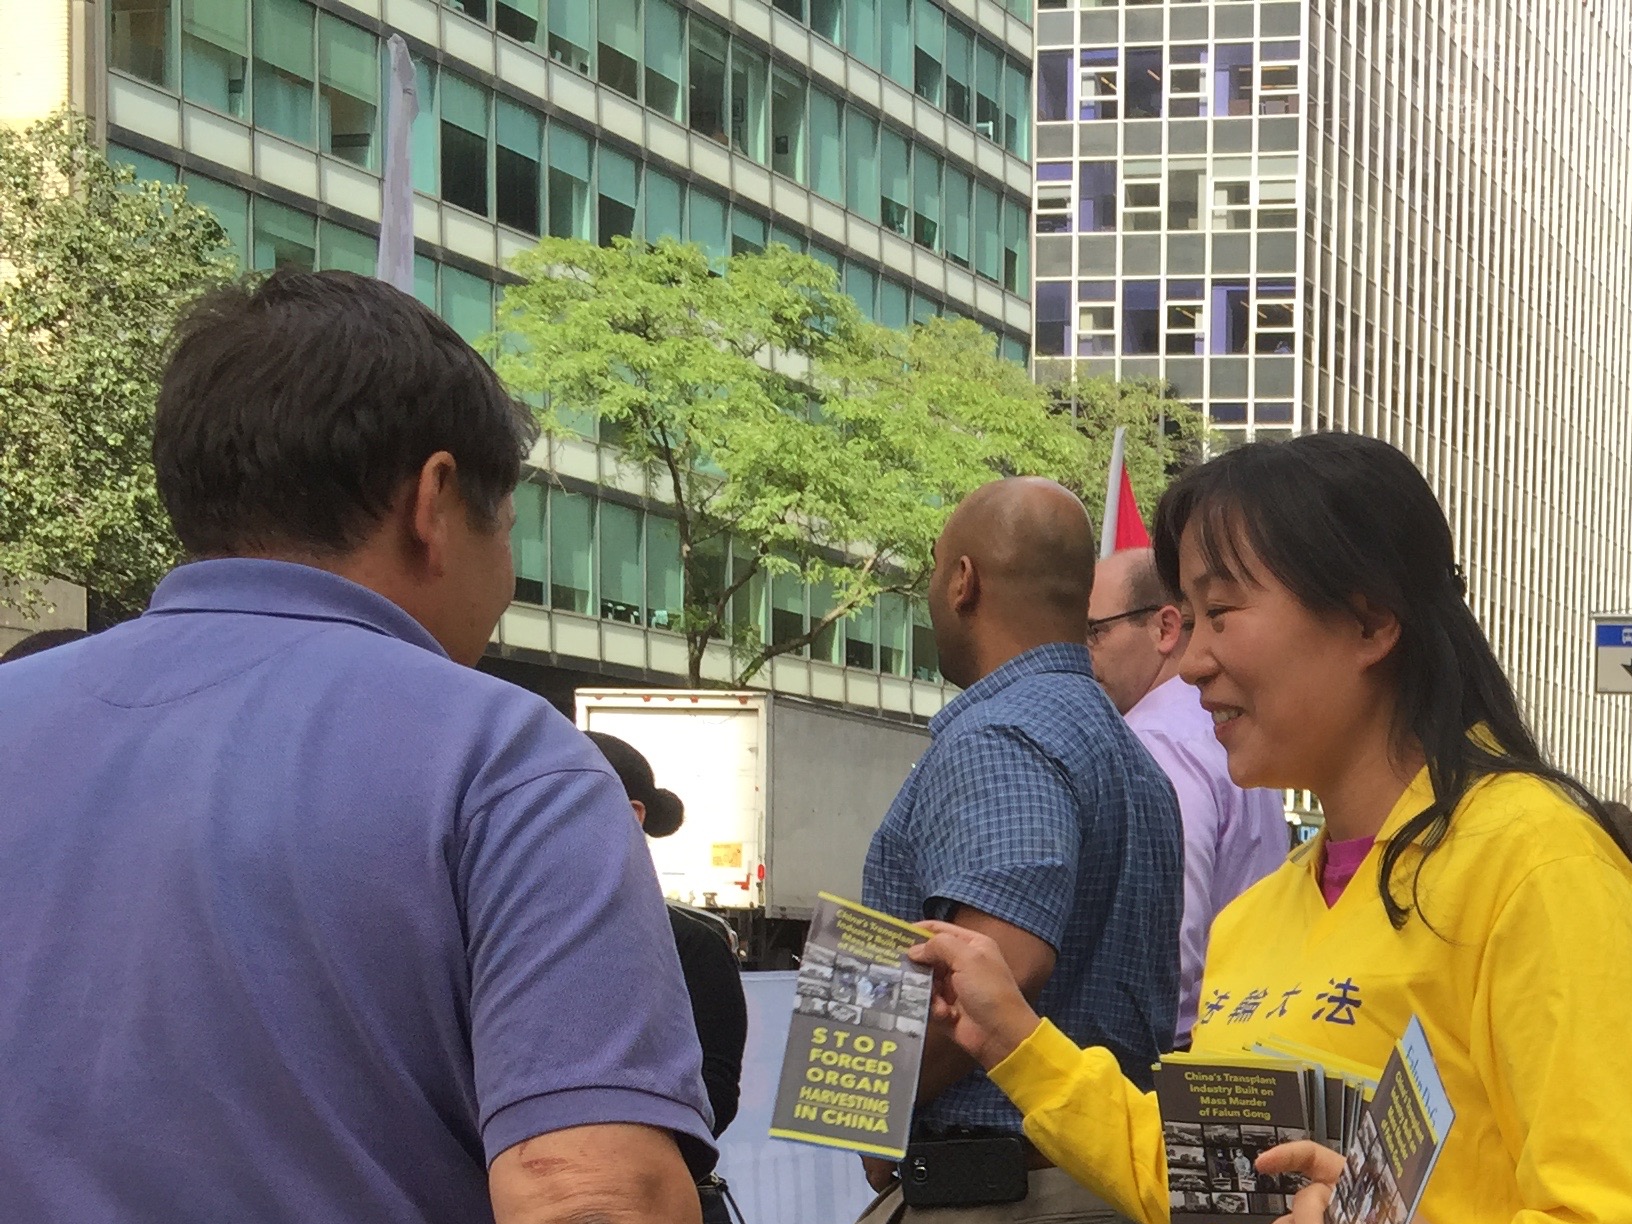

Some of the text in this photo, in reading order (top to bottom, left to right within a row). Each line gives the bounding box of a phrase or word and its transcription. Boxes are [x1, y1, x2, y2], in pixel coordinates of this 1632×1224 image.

[811, 1026, 898, 1057] STOP
[809, 1047, 894, 1076] FORCED
[806, 1067, 890, 1095] ORGAN
[1184, 1071, 1277, 1086] China's Transplant
[1189, 1084, 1274, 1097] Industry Built on
[799, 1086, 890, 1115] HARVESTING
[1199, 1107, 1271, 1121] of Falun Gong
[1200, 1096, 1267, 1107] Mass Murder
[793, 1103, 889, 1134] IN CHINA
